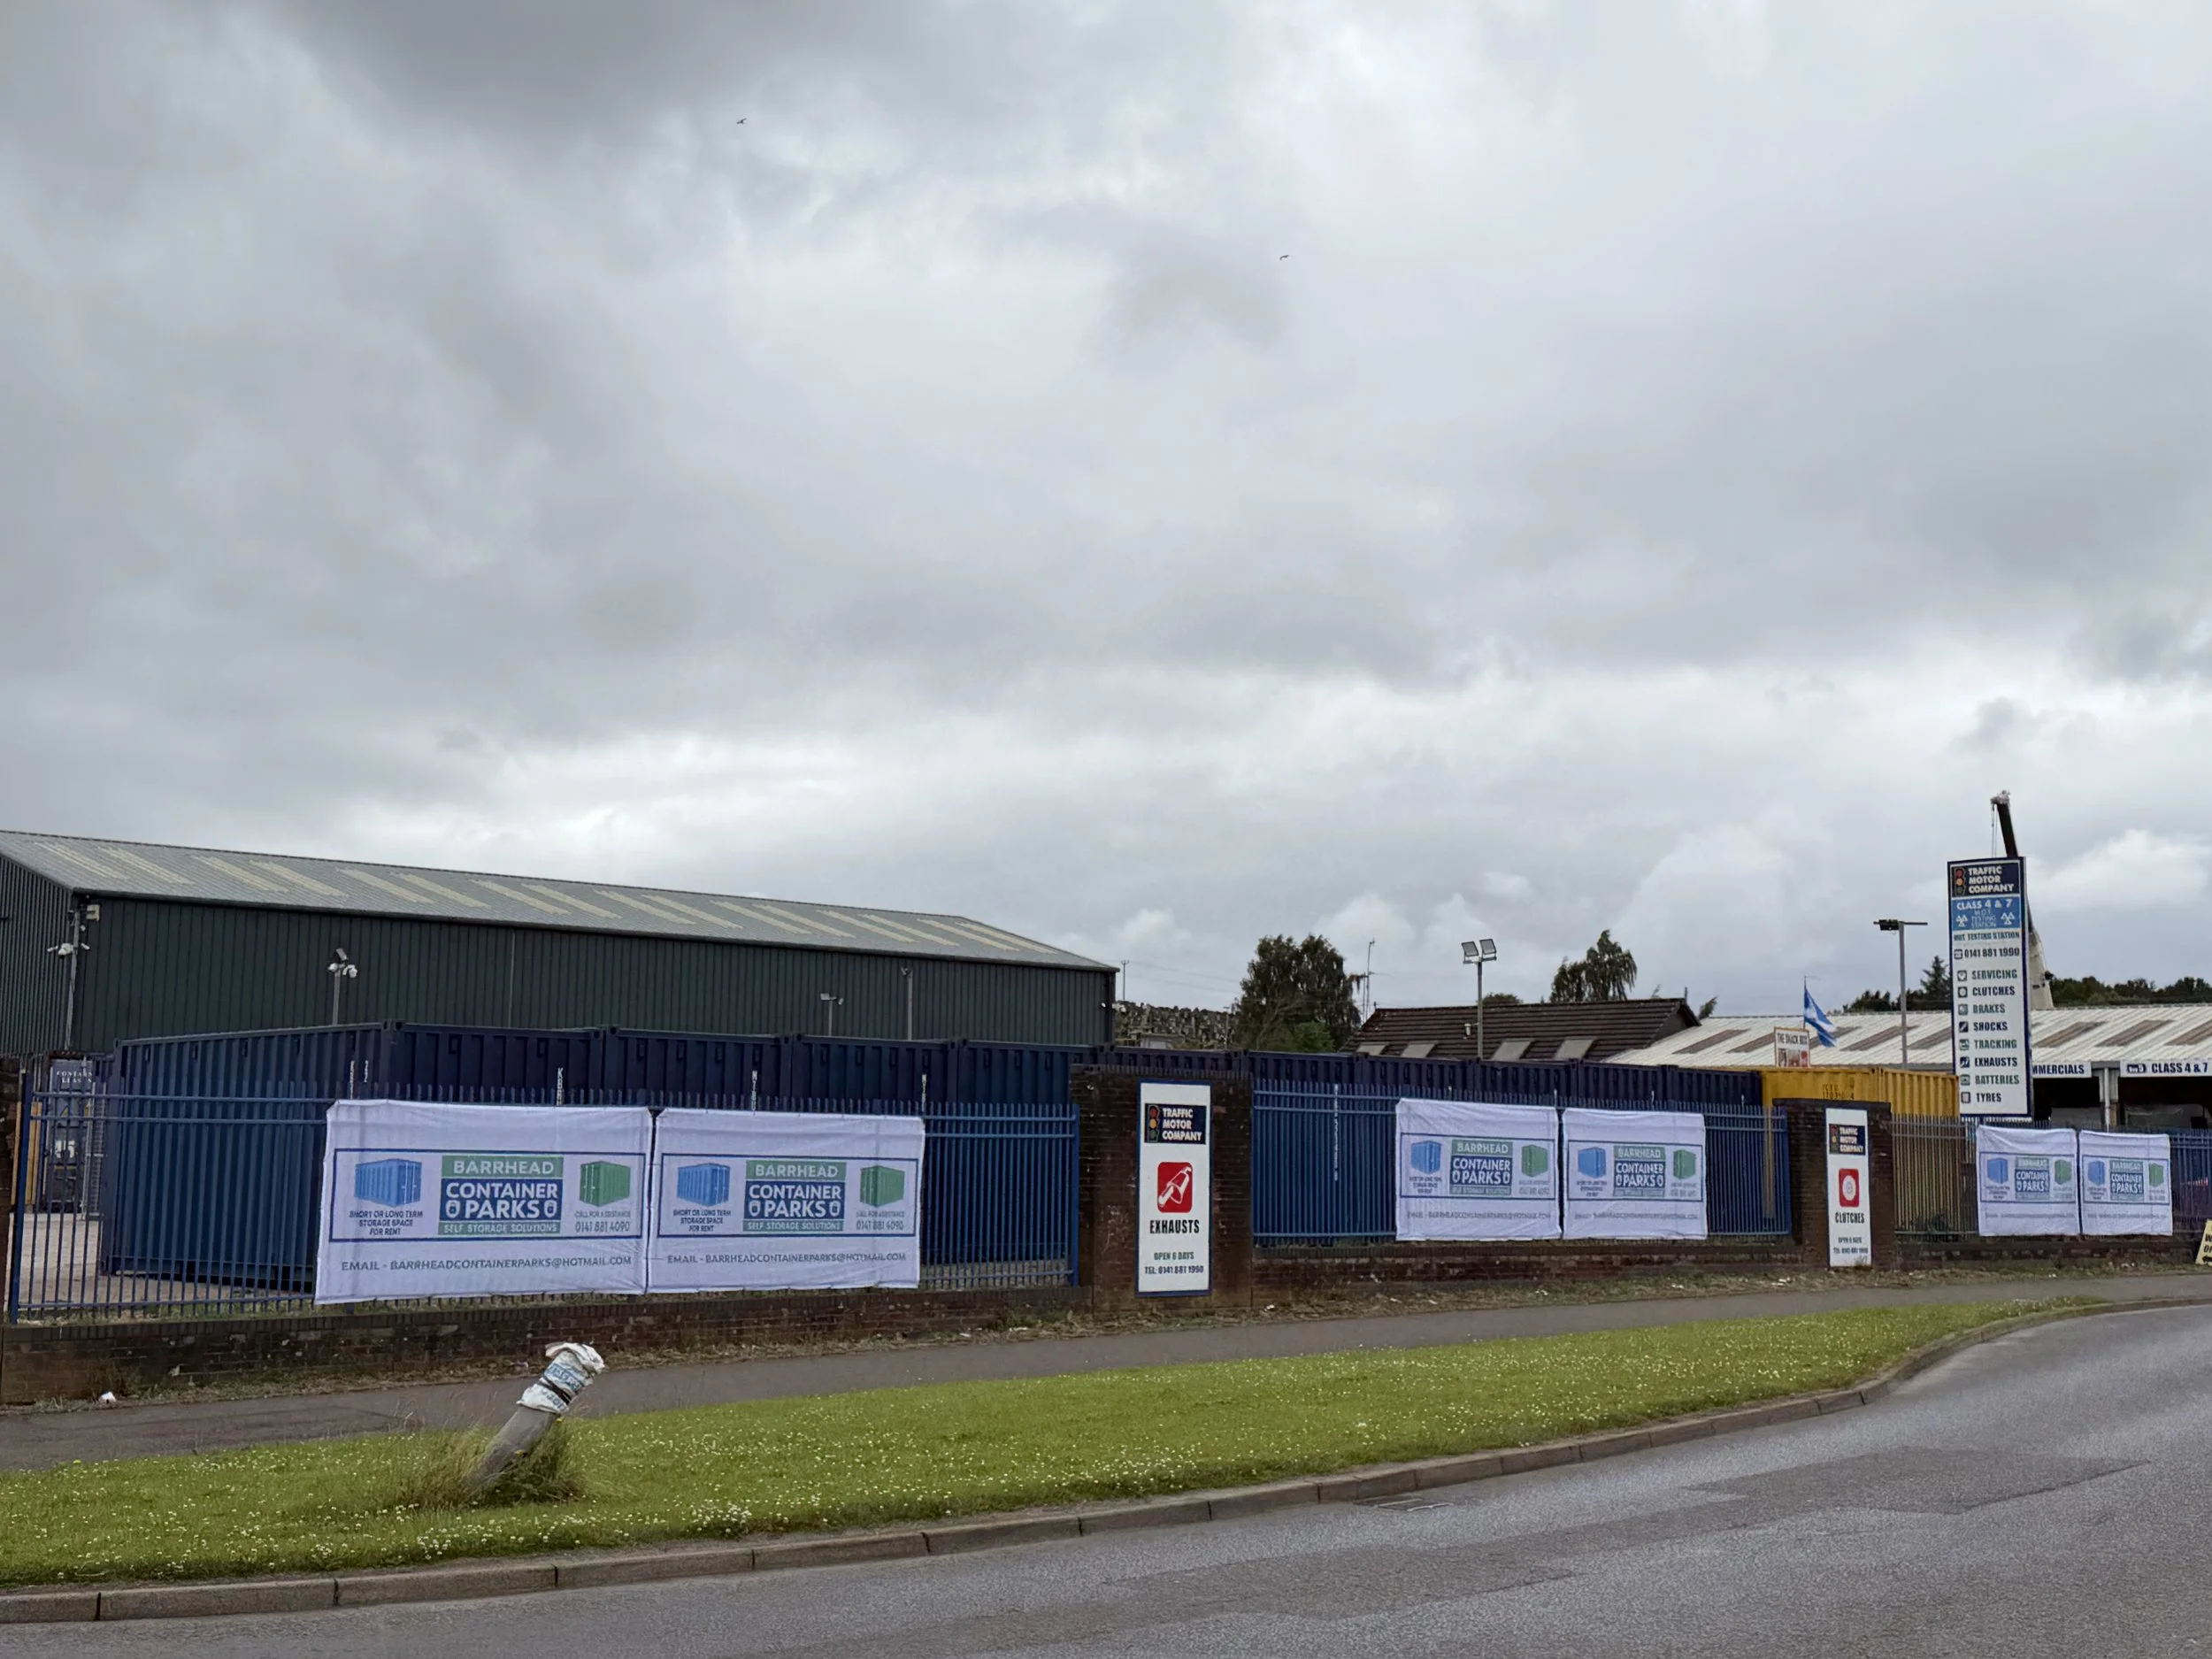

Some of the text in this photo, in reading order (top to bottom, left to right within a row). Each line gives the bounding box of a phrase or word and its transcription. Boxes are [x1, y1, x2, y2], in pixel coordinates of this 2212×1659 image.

[1968, 866, 2002, 876] TRAFFIC
[1969, 875, 2001, 885] MOTOR
[1969, 884, 2014, 894] COMPANY
[1956, 900, 1982, 910] CLASS
[2006, 898, 2013, 908] 7
[1964, 949, 1981, 958] 0141
[2000, 947, 2020, 956] 1990
[1971, 970, 2017, 980] SERVICING
[1972, 986, 2016, 996] CLUTCHES
[1973, 1004, 2005, 1014] BRAKES
[1973, 1022, 2008, 1032] SHOCKS
[1974, 1040, 2017, 1049] TRACKING
[1975, 1057, 2018, 1067] EXHAUSTS
[2152, 1063, 2208, 1073] CLASS 4 & 7
[1975, 1075, 2020, 1085] BATTERIES
[1976, 1093, 2002, 1102] TYRES
[1163, 1108, 1194, 1118] TRAFFIC
[1163, 1119, 1192, 1130] MOTOR
[1162, 1130, 1202, 1141] COMPANY
[1457, 1143, 1509, 1154] BARRHEAD
[453, 1161, 554, 1174] BARRHEAD
[1453, 1158, 1510, 1171] CONTAINER
[1616, 1163, 1663, 1174] CONTAINER
[756, 1164, 838, 1178] BARRHEAD
[1463, 1171, 1501, 1185] PARKS
[1624, 1174, 1655, 1187] PARKS
[446, 1182, 557, 1199] CONTAINER
[2023, 1180, 2044, 1191] PARKS
[2116, 1182, 2138, 1194] PARKS
[749, 1185, 841, 1199] CONTAINER
[465, 1200, 540, 1218] PARKS
[764, 1200, 826, 1217] PARKS
[1835, 1212, 1864, 1224] CLUTCHES
[444, 1224, 557, 1233] SELF STORAGE SOLUTIONS
[575, 1221, 593, 1233] 0141
[610, 1221, 630, 1232] 4090
[1149, 1219, 1200, 1234] EXHAUSTS
[667, 1255, 698, 1263] EMAIL
[1154, 1252, 1171, 1261] OPEN
[1179, 1251, 1194, 1260] DAYS
[342, 1261, 380, 1271] EMAIL
[390, 1256, 632, 1271] BARRHEADCONTAINERPARKS@HOTMAIL.COM
